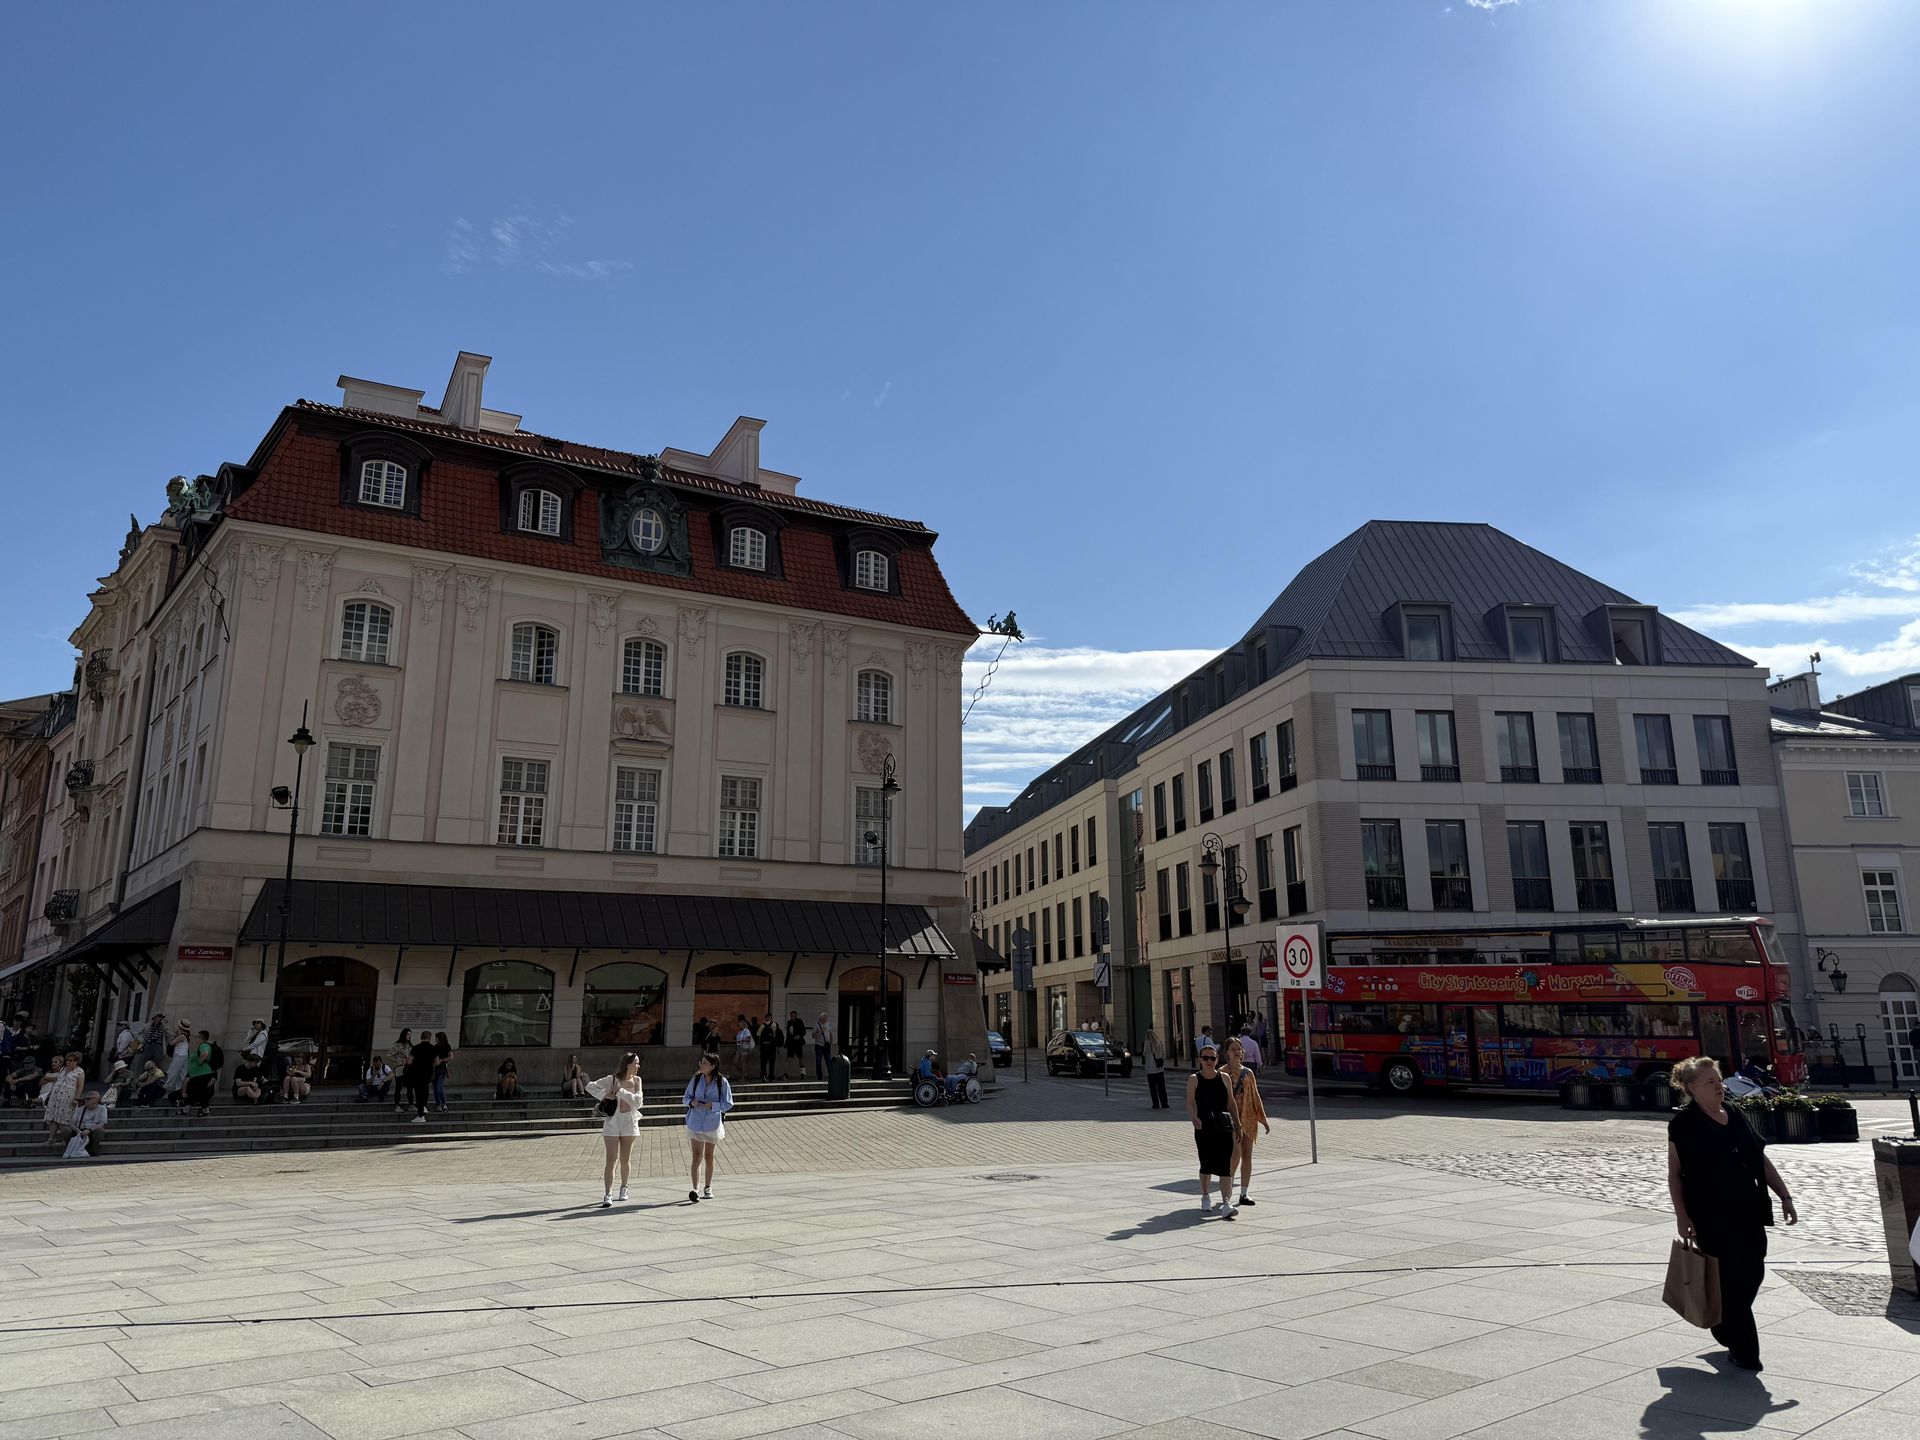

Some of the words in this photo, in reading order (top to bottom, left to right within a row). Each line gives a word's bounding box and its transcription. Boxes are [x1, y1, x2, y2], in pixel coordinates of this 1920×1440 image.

[1288, 947, 1308, 967] 30
[1547, 974, 1604, 992] Warsaw
[1664, 971, 1697, 990] OFFICIAL
